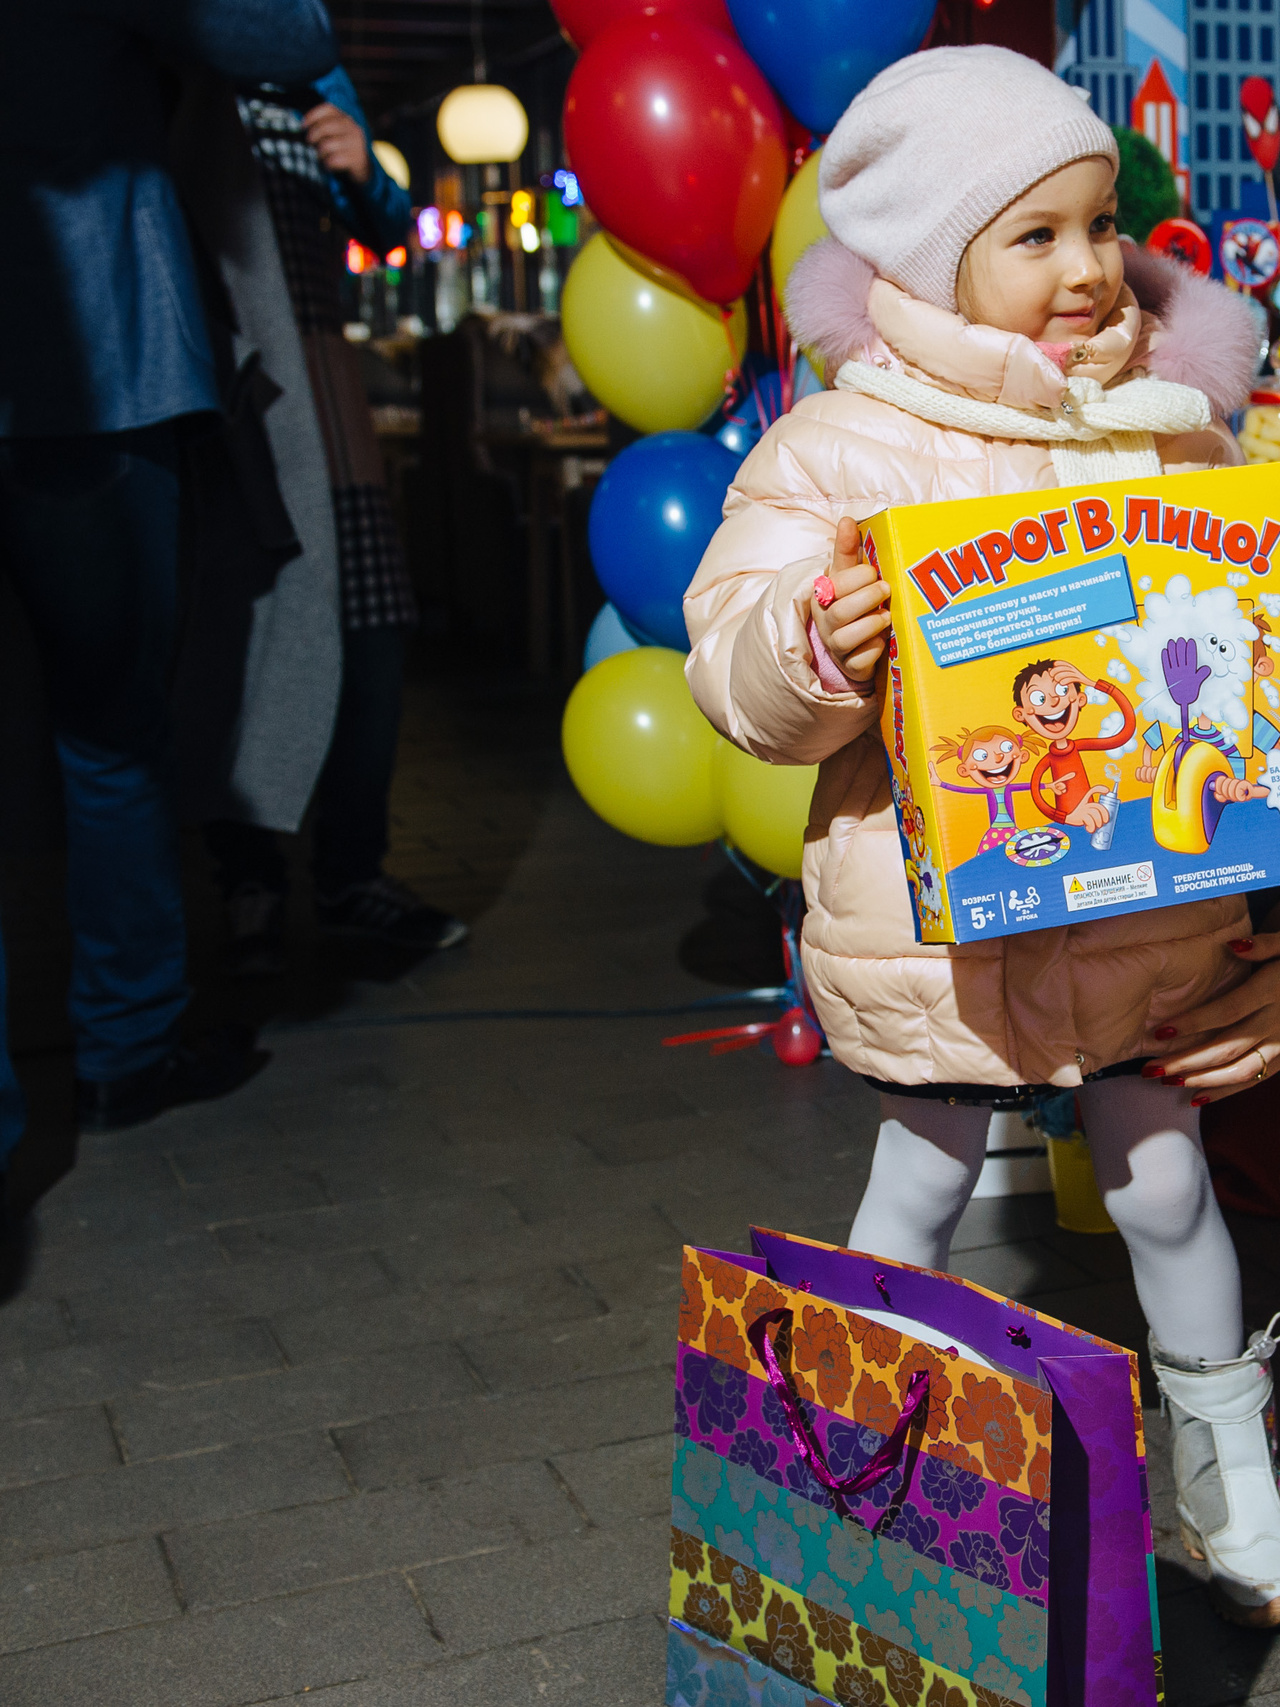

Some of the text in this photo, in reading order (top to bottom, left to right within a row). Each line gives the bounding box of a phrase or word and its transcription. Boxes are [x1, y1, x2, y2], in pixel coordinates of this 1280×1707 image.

[926, 570, 1121, 630] Поместите голову в маску и начинайте
[931, 606, 1041, 641] поворачивать ручки.
[935, 603, 1087, 652] Теперь берегитесь! Вас может
[940, 615, 1082, 663] ожидать большой сюрприз!
[1086, 873, 1135, 891] ВНИМАНИЕ:
[1173, 862, 1254, 884] ТРЕБУЕТСЯ ПОМОЩЬ
[1174, 870, 1266, 894] ВЗРОСЛЫХ ПРИ СБОРКЕ
[961, 893, 996, 906] ВОЗРАСТ
[970, 906, 995, 930] 5+
[1015, 913, 1038, 922] ИГРОКА
